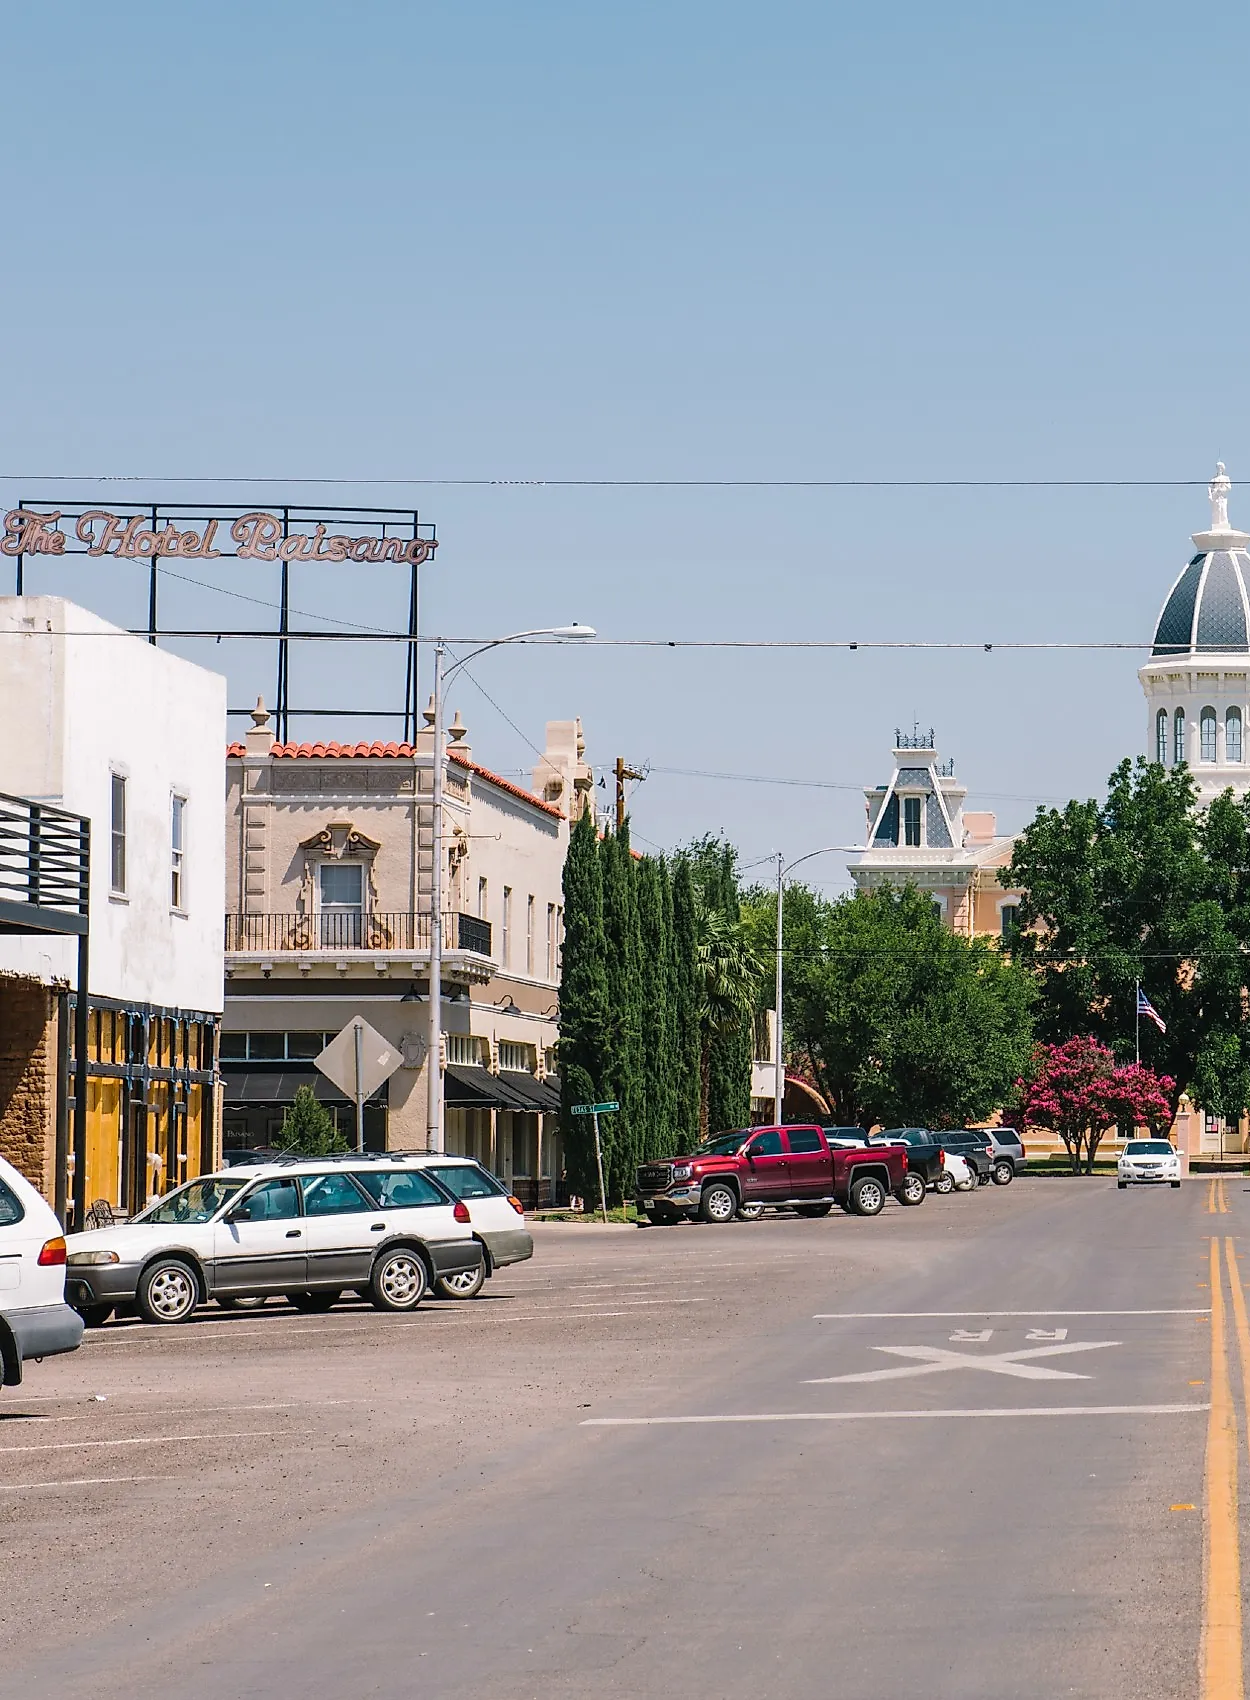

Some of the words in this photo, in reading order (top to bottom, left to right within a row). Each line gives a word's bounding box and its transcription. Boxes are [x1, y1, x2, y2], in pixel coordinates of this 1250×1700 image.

[0, 508, 66, 557] The
[75, 510, 221, 559] Hotel
[230, 511, 439, 566] Paisano
